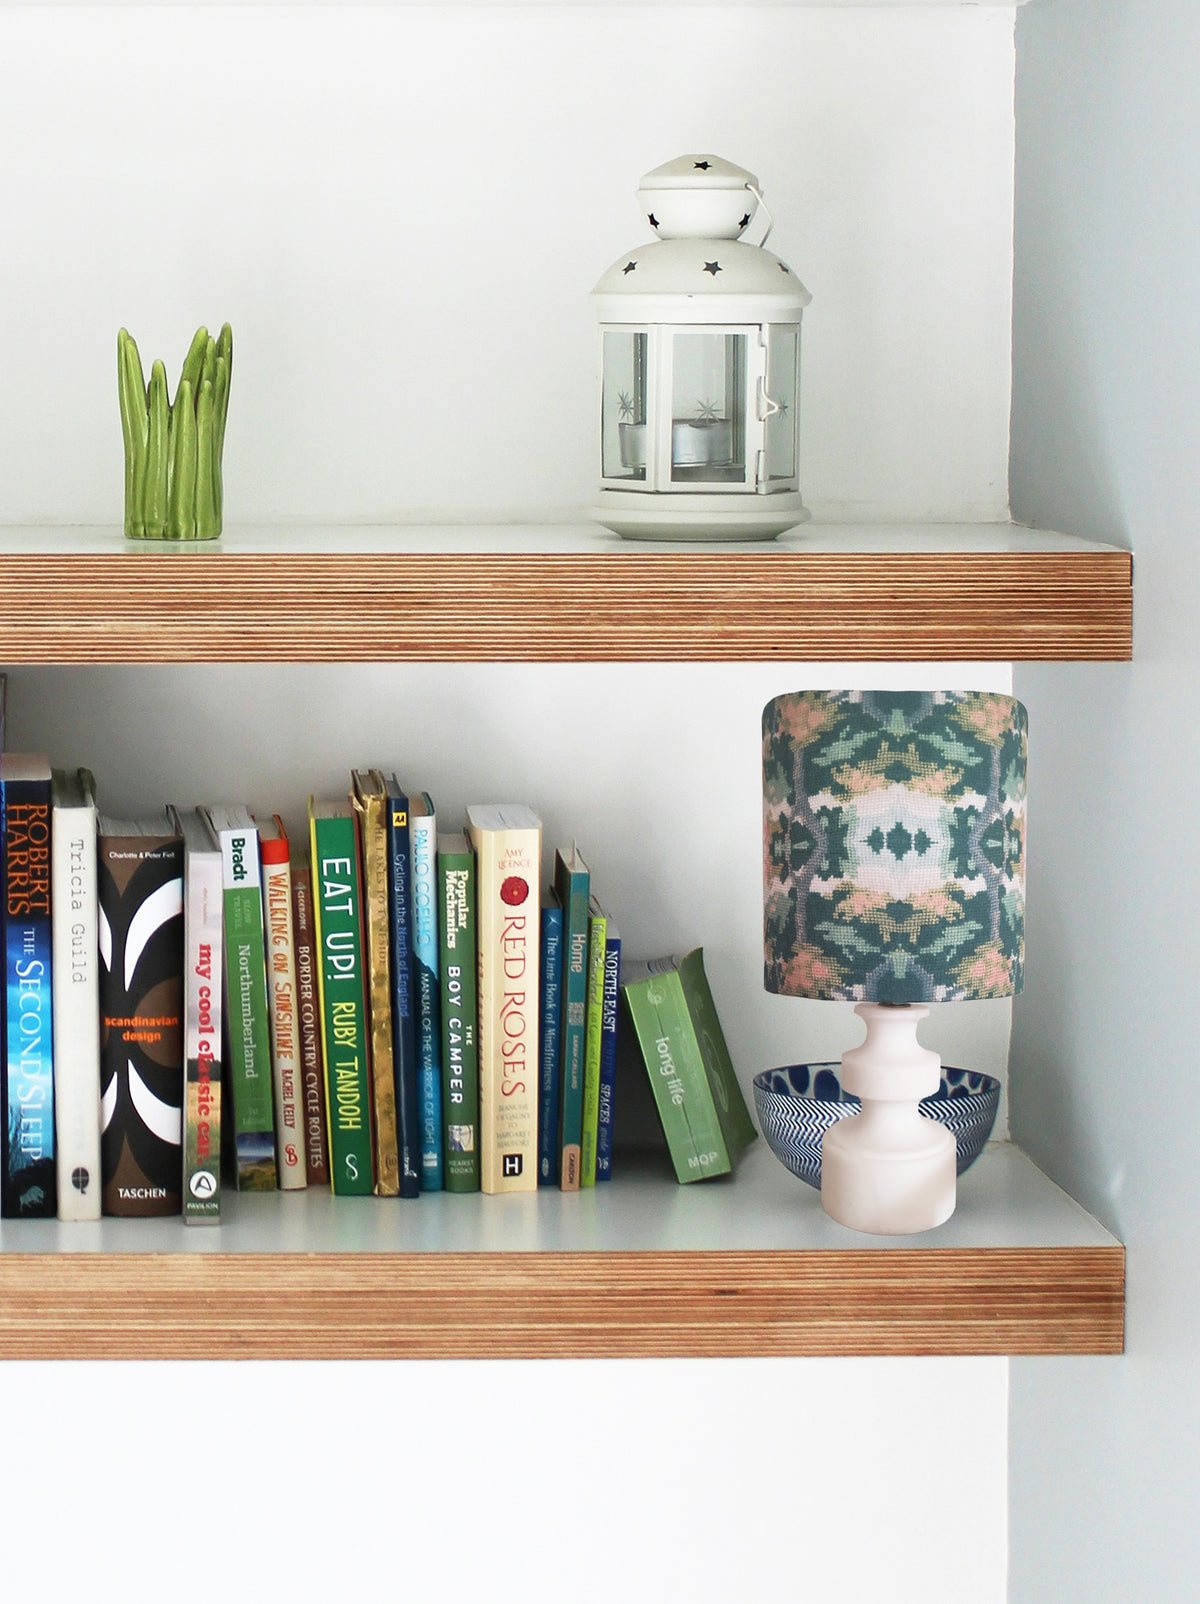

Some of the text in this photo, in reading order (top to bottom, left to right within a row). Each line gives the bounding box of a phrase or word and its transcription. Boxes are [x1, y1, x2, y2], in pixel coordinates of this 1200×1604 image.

[7, 804, 30, 915] HARRIS
[28, 803, 49, 915] ROBERT
[109, 851, 137, 859] Charlotte
[231, 838, 247, 881] Bradt
[375, 846, 385, 880] LAKES
[498, 859, 531, 870] LICENCE
[505, 848, 523, 858] AMY
[377, 887, 385, 903] TO
[415, 828, 430, 945] PAULO COELHO
[457, 870, 469, 929] Popular
[70, 839, 86, 983] Tricia Guild
[445, 870, 457, 949] Mechanics
[394, 854, 409, 1017] Cycling in the North of England
[547, 936, 558, 955] The
[571, 933, 586, 973] Home
[195, 943, 213, 980] my
[546, 957, 555, 980] Little
[198, 986, 215, 1034] cool
[238, 944, 258, 1079] Northumberland
[268, 872, 295, 1129] WALKING ON SUNSHINE RACHEL KELLY
[323, 857, 361, 1129] EAT UP! RUBY TANDOH
[500, 916, 526, 1097] RED ROSES
[545, 983, 558, 1009] Book
[105, 1016, 178, 1027] scandinavian
[122, 1031, 161, 1042] design
[448, 965, 462, 1104] BOY CAMPER
[465, 1025, 473, 1045] THE
[545, 1012, 556, 1024] of
[15, 928, 46, 1160] THE SECOND SLEEP
[298, 945, 323, 1168] BORDER COUNTRY CYCLE ROUTES
[421, 972, 434, 1144] MANUAL OF THE WARRIOR OF LIGHT
[543, 1028, 556, 1090] Mindfulness
[197, 1040, 216, 1116] classic
[655, 1036, 685, 1106] long life
[600, 1083, 612, 1124] SPACES
[505, 1156, 519, 1175] H
[688, 1151, 719, 1169] MQP
[118, 1188, 166, 1199] TASCHEN
[187, 1202, 219, 1210] PAVILION
